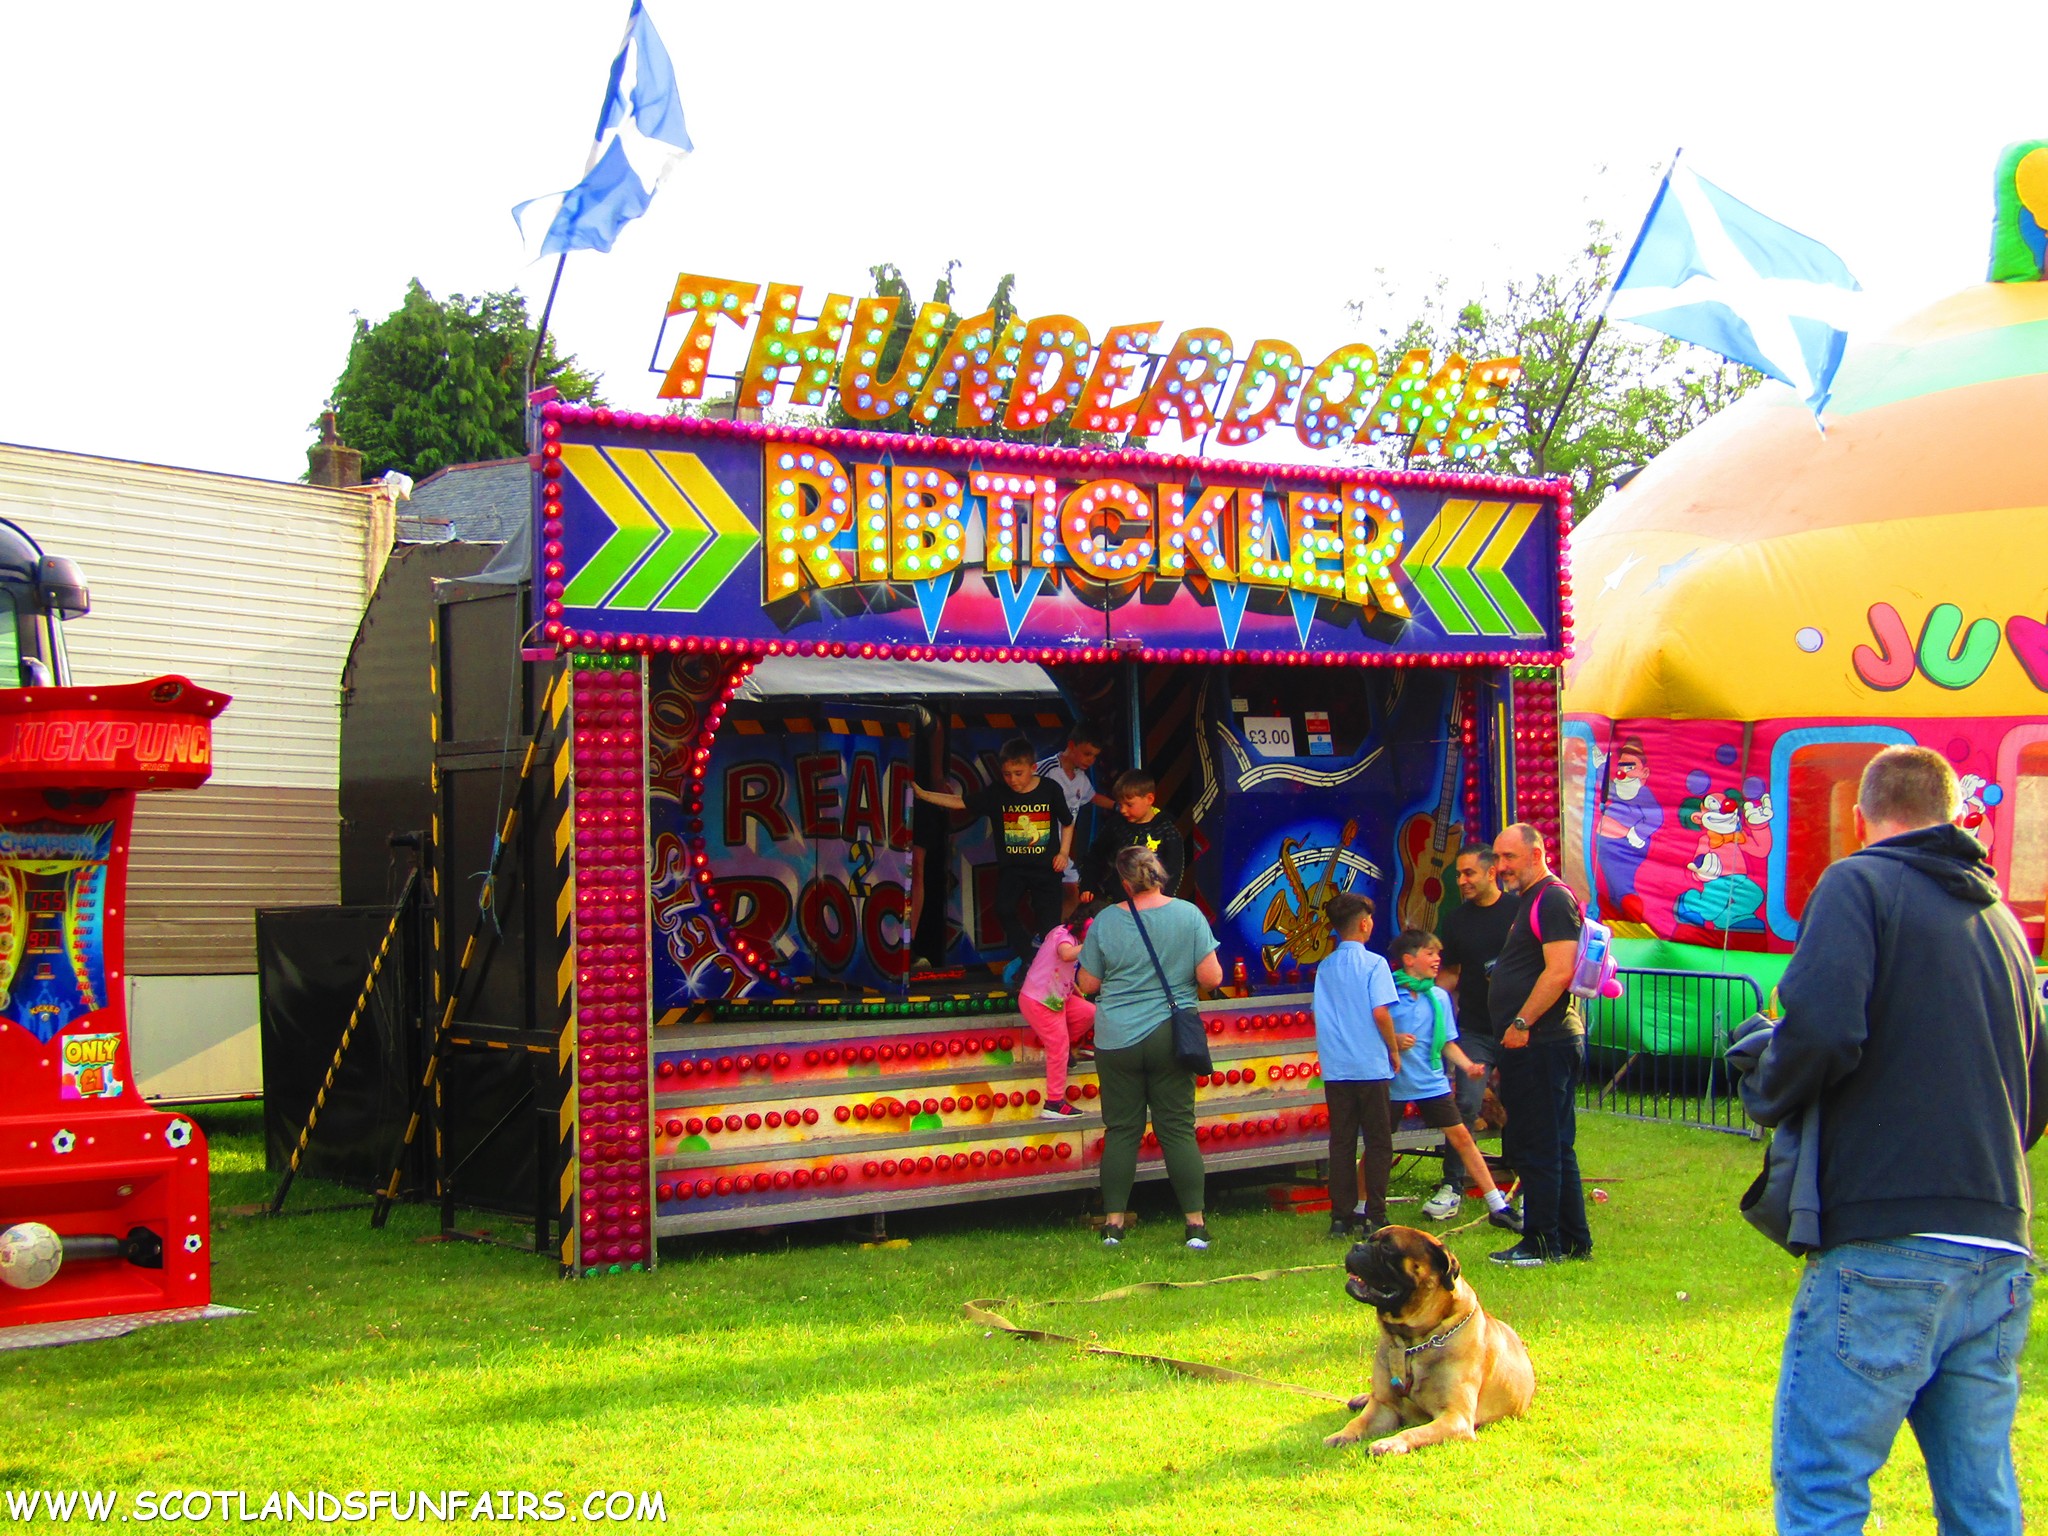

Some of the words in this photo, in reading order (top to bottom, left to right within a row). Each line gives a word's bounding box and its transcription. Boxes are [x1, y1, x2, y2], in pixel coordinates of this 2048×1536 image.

[657, 273, 1521, 458] THUNDERDOME
[1249, 729, 1290, 745] £3.00
[848, 839, 877, 898] 2
[32, 892, 64, 911] 155
[29, 932, 61, 949] 937
[65, 1038, 118, 1065] ONLY
[80, 1067, 105, 1094] £1
